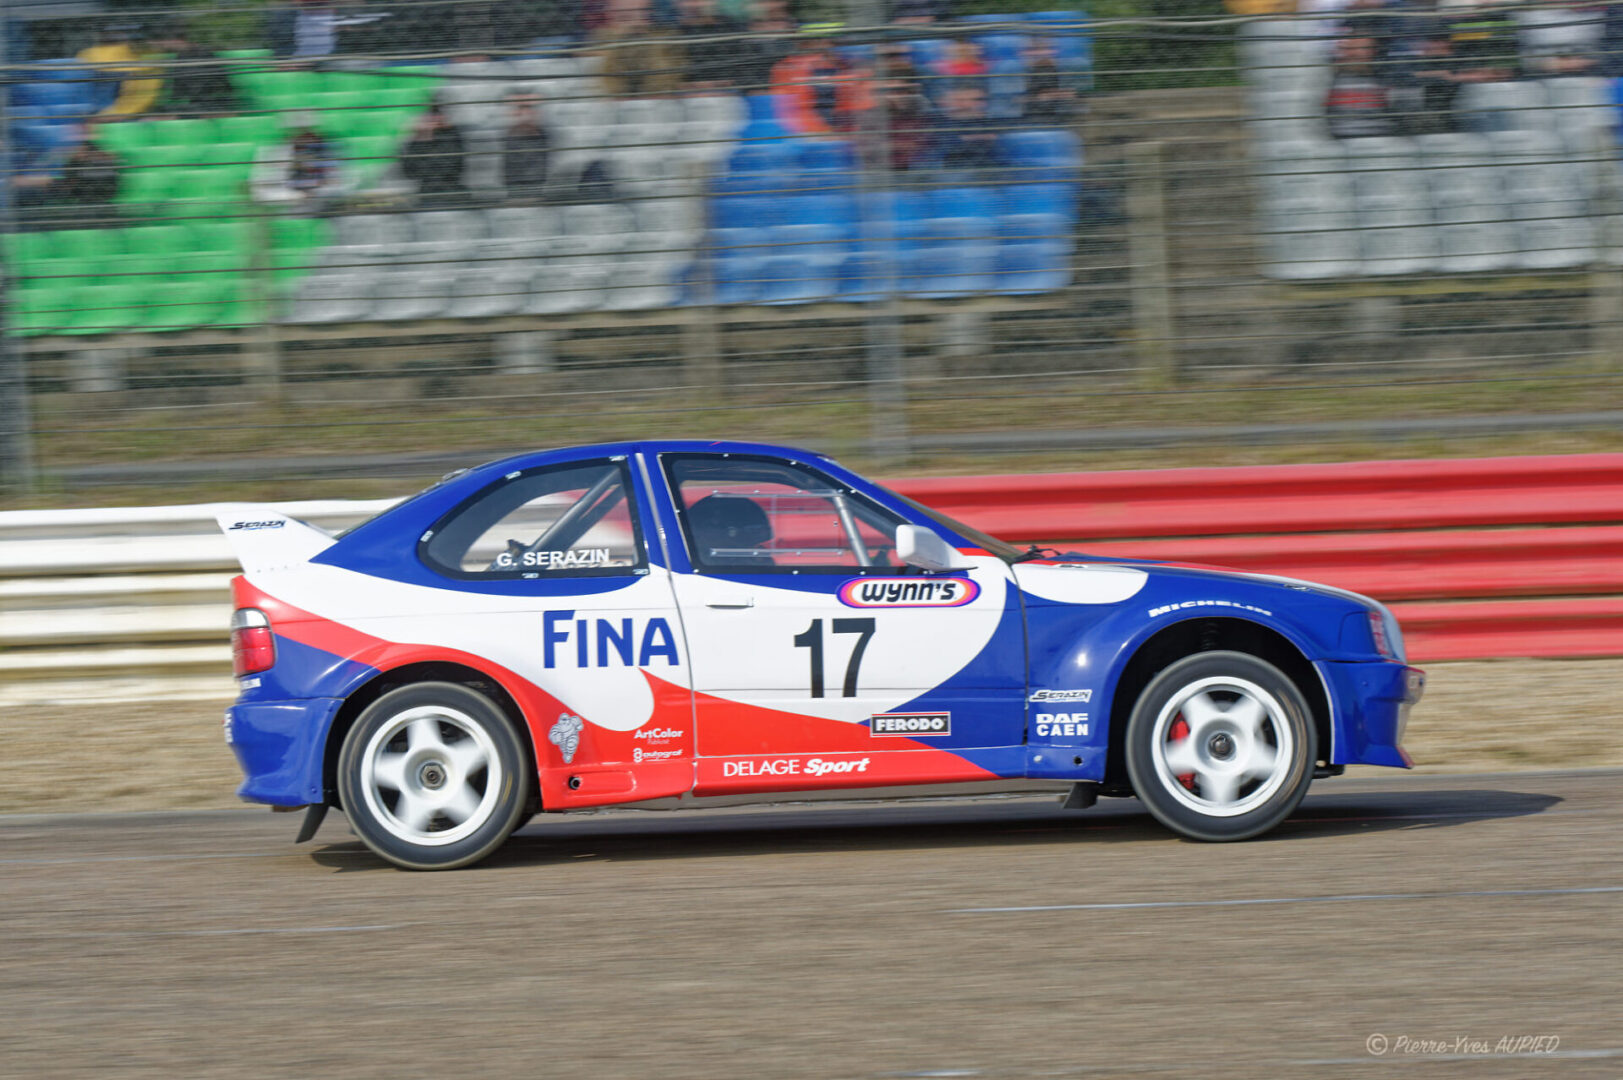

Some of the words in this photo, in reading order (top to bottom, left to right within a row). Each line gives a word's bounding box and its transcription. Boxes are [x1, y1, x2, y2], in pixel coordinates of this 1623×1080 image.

[497, 552, 517, 567] G.
[523, 548, 610, 566] SERAZIN
[543, 610, 679, 668] FINA
[794, 617, 876, 698] 17
[876, 717, 945, 731] FERODO
[1036, 713, 1089, 724] DAF
[634, 728, 684, 739] ArtColor
[1036, 724, 1089, 736] CAEN
[723, 759, 800, 777] DELAGE
[804, 758, 870, 776] Sport
